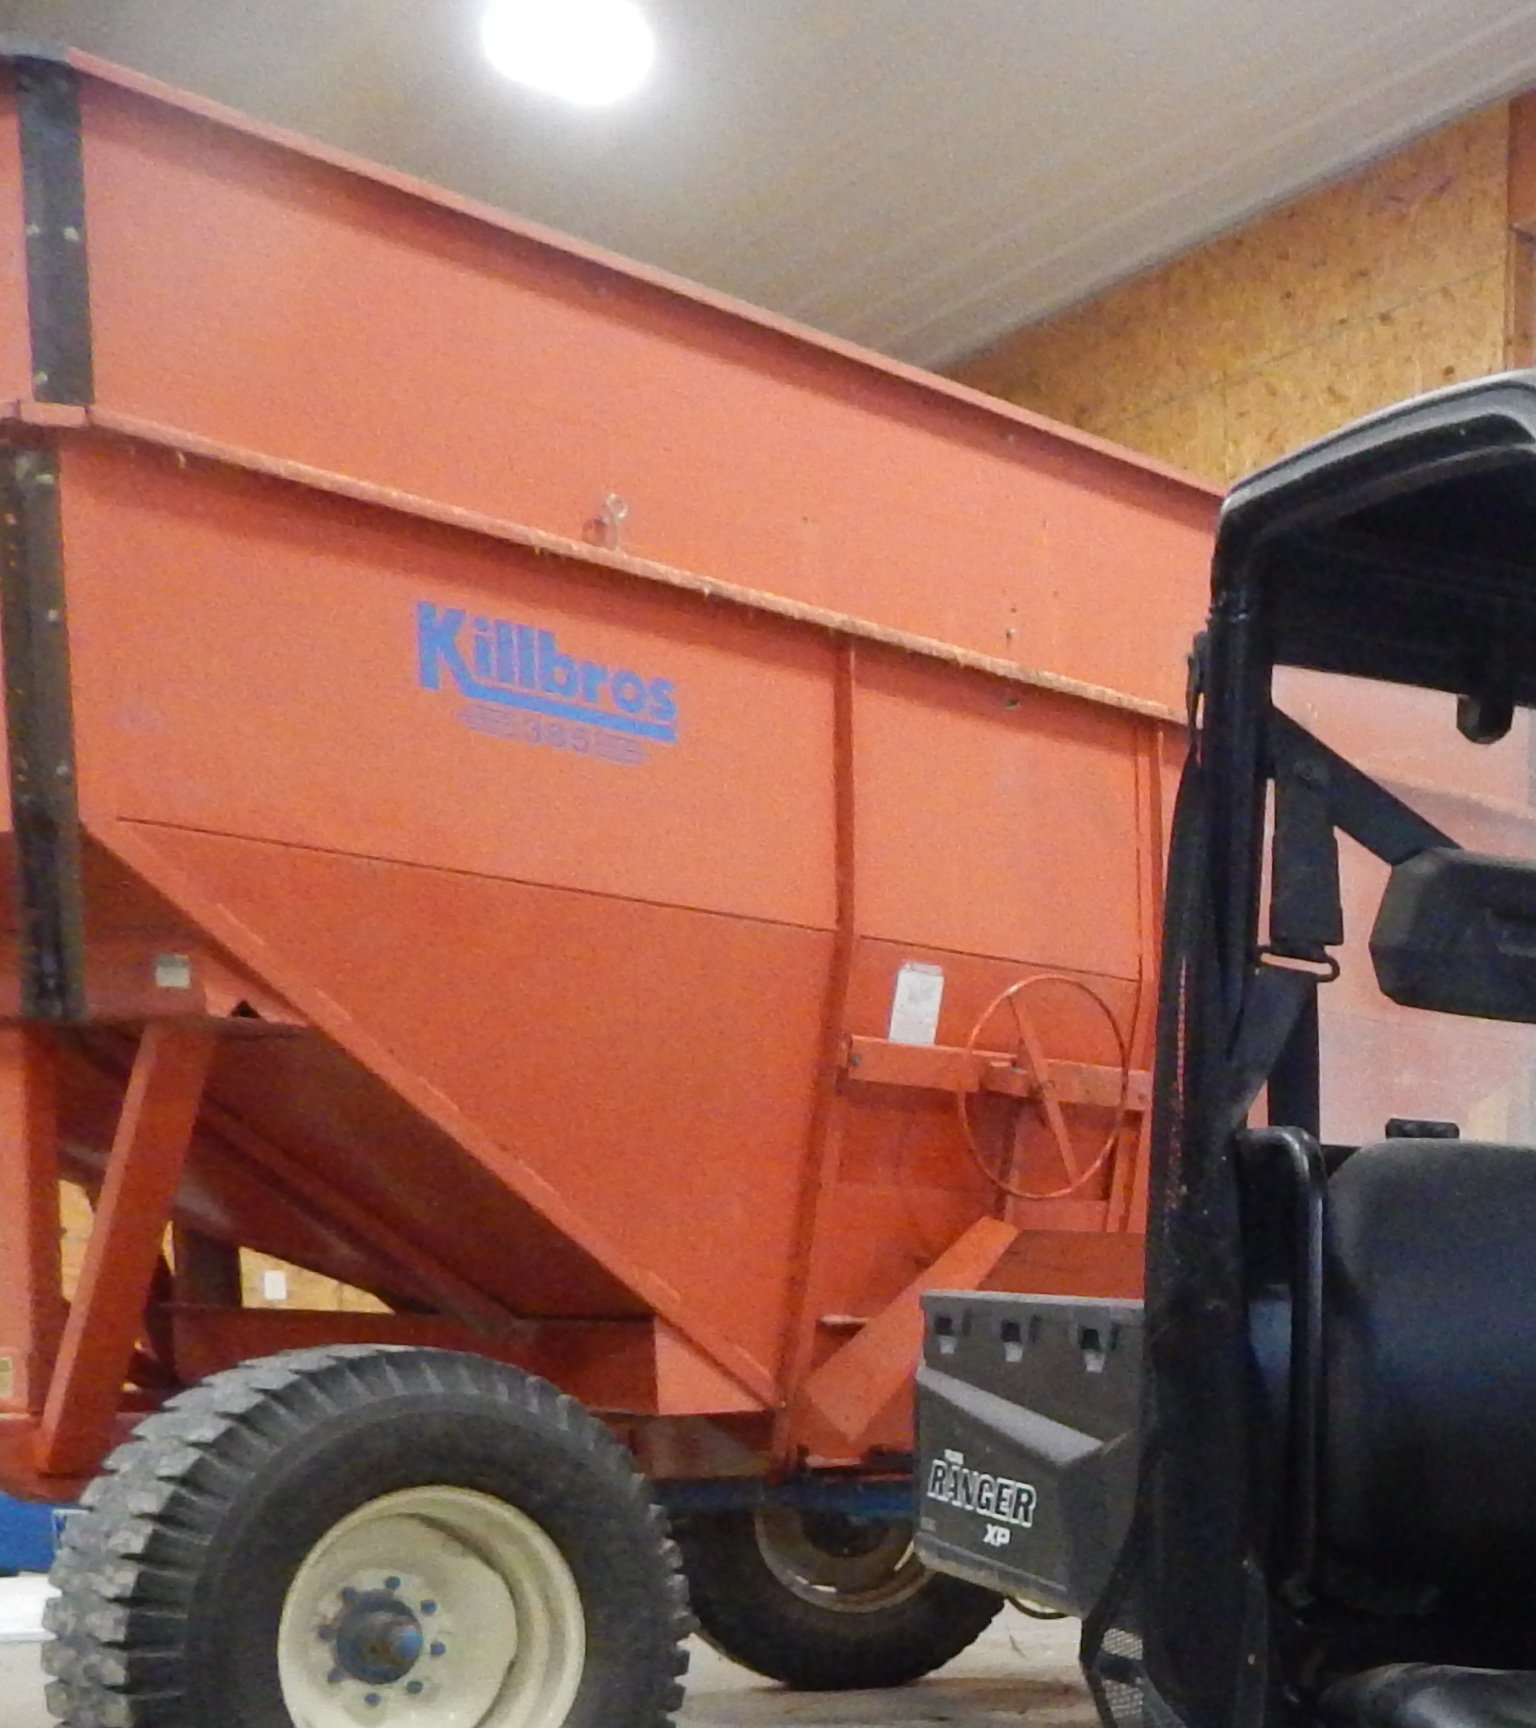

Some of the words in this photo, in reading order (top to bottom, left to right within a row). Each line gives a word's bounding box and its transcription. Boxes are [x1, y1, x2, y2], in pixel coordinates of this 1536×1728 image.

[416, 601, 677, 724] Killbros
[927, 1458, 1037, 1528] RANGER
[983, 1523, 1011, 1547] XP
